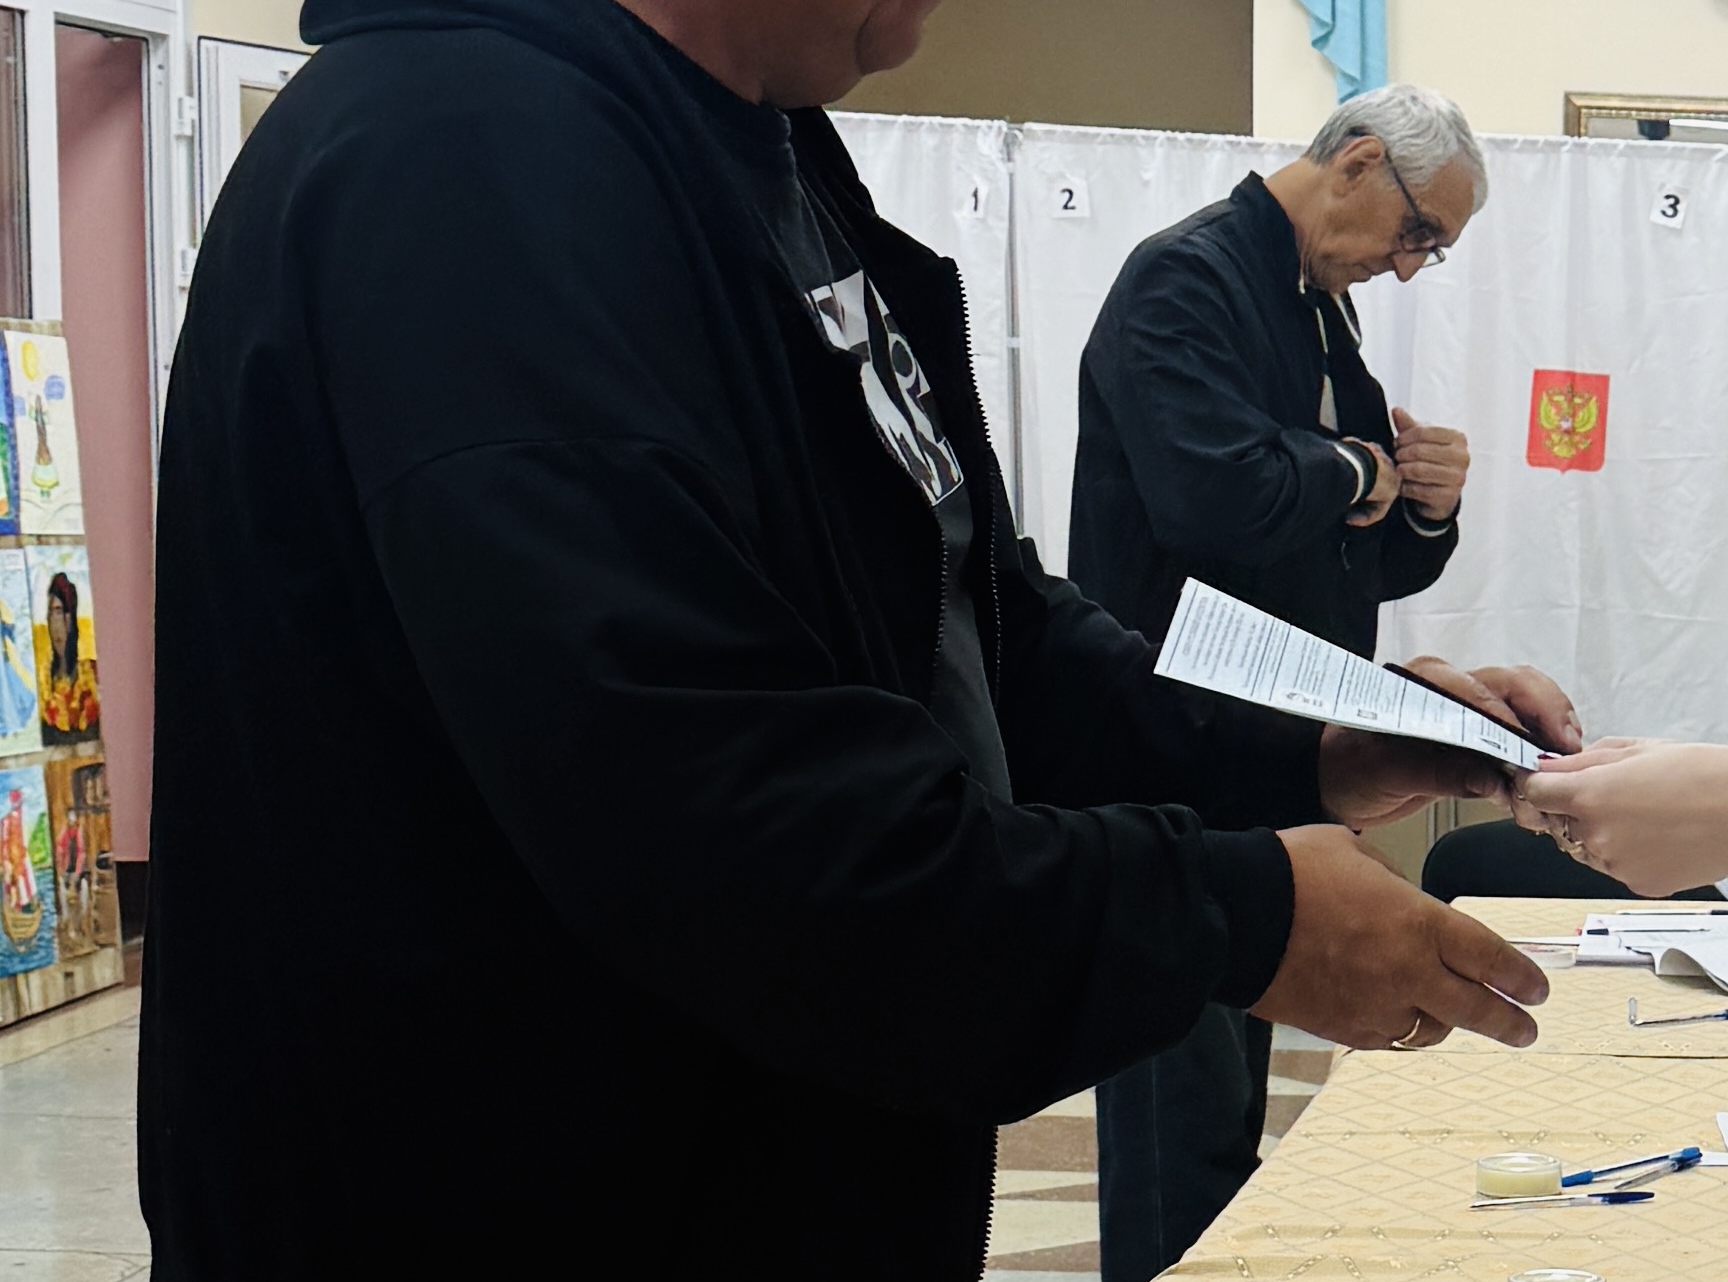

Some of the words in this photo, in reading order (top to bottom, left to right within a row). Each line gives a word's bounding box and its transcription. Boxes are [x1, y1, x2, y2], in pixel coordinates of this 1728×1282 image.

[972, 186, 979, 213] 1
[1060, 187, 1077, 211] 2
[1660, 193, 1681, 219] 3
